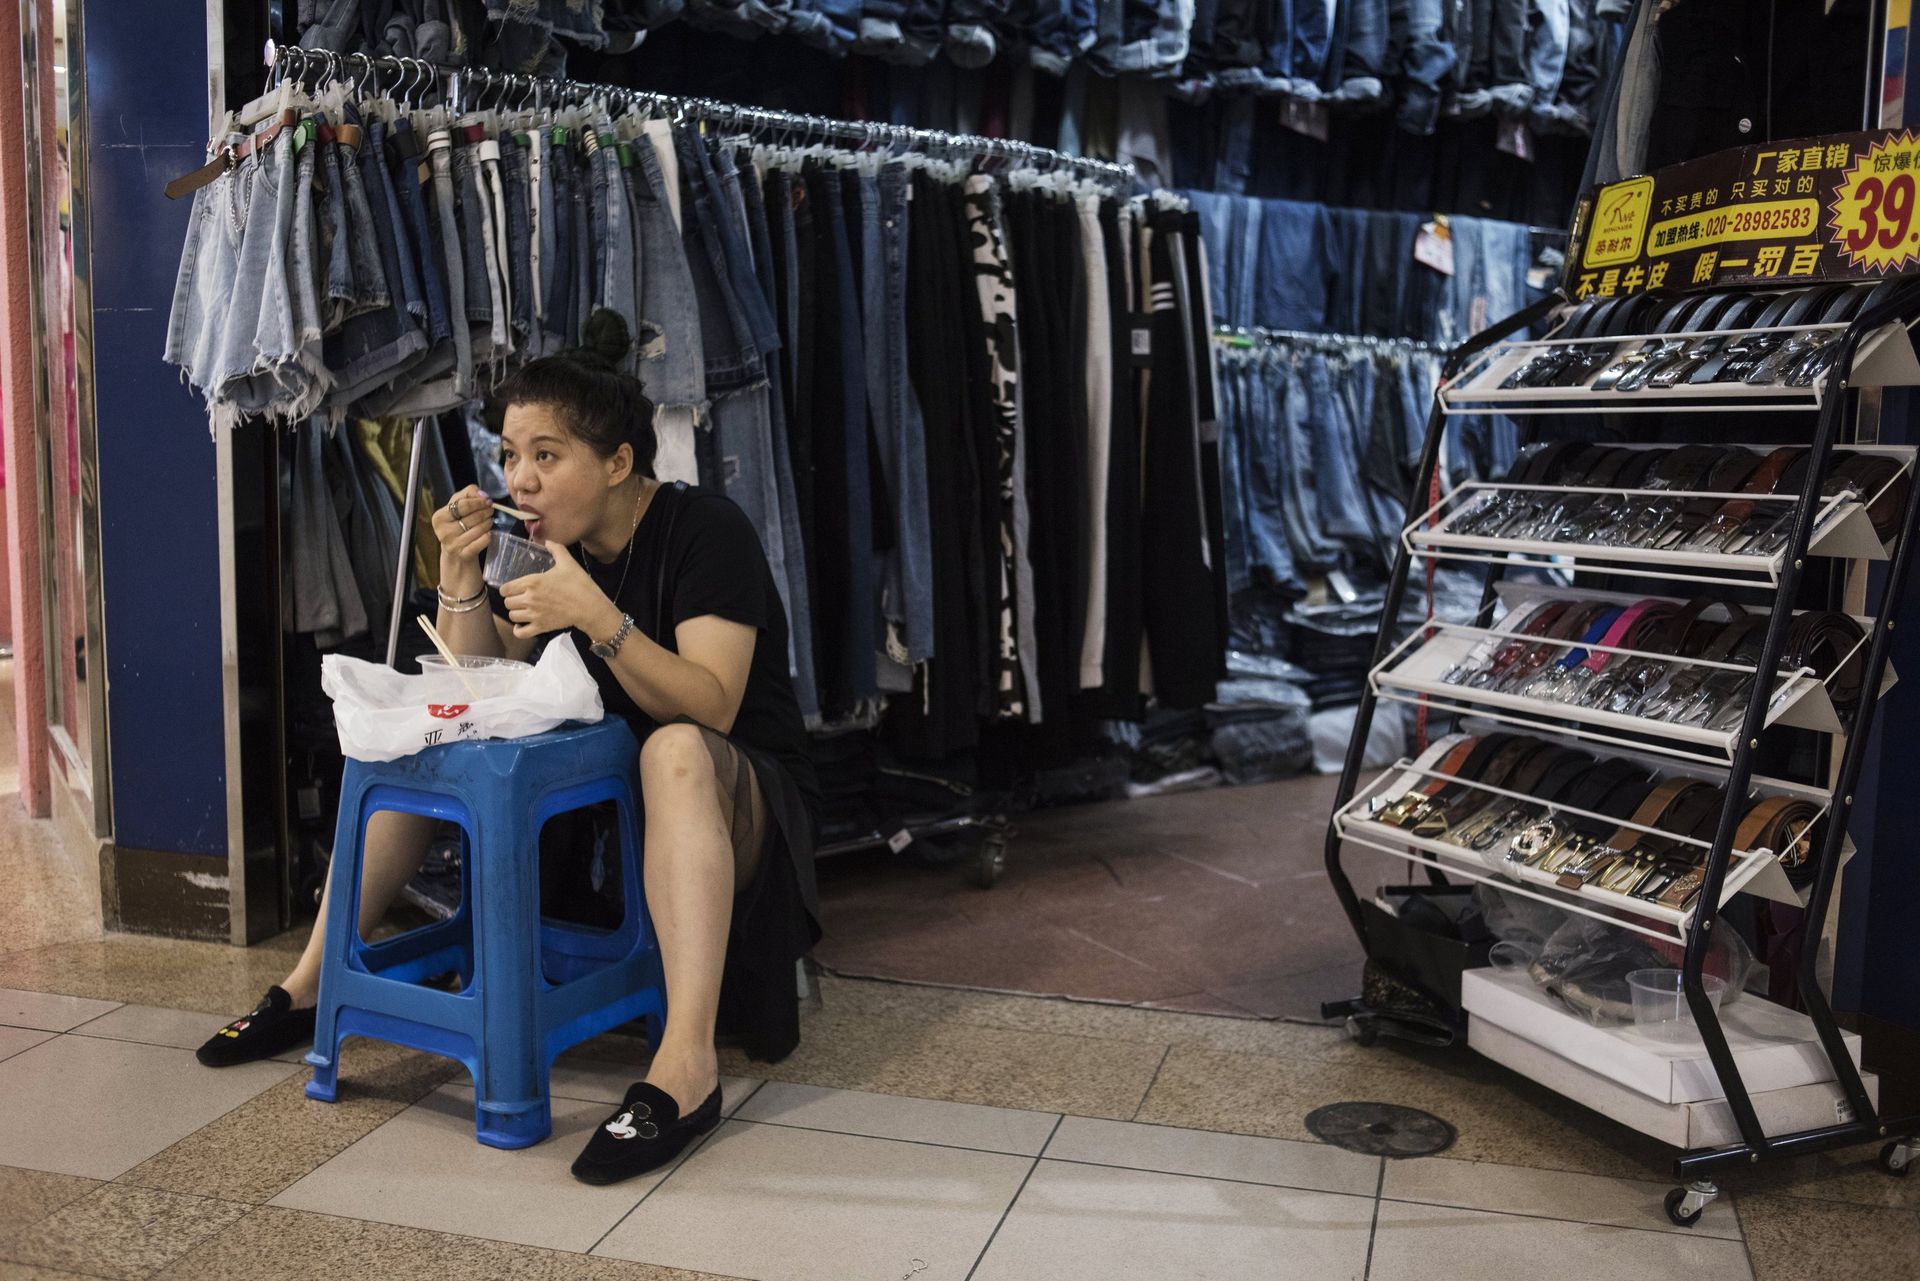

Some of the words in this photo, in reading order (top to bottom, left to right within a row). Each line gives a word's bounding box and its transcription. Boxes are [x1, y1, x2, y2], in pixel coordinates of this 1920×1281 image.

[1753, 143, 1850, 176] 厂家直销
[1661, 188, 1718, 216] 不买贵的
[1730, 175, 1814, 200] 只买对的
[1575, 261, 1670, 300] 不是牛皮
[1692, 244, 1823, 284] 假一罚百
